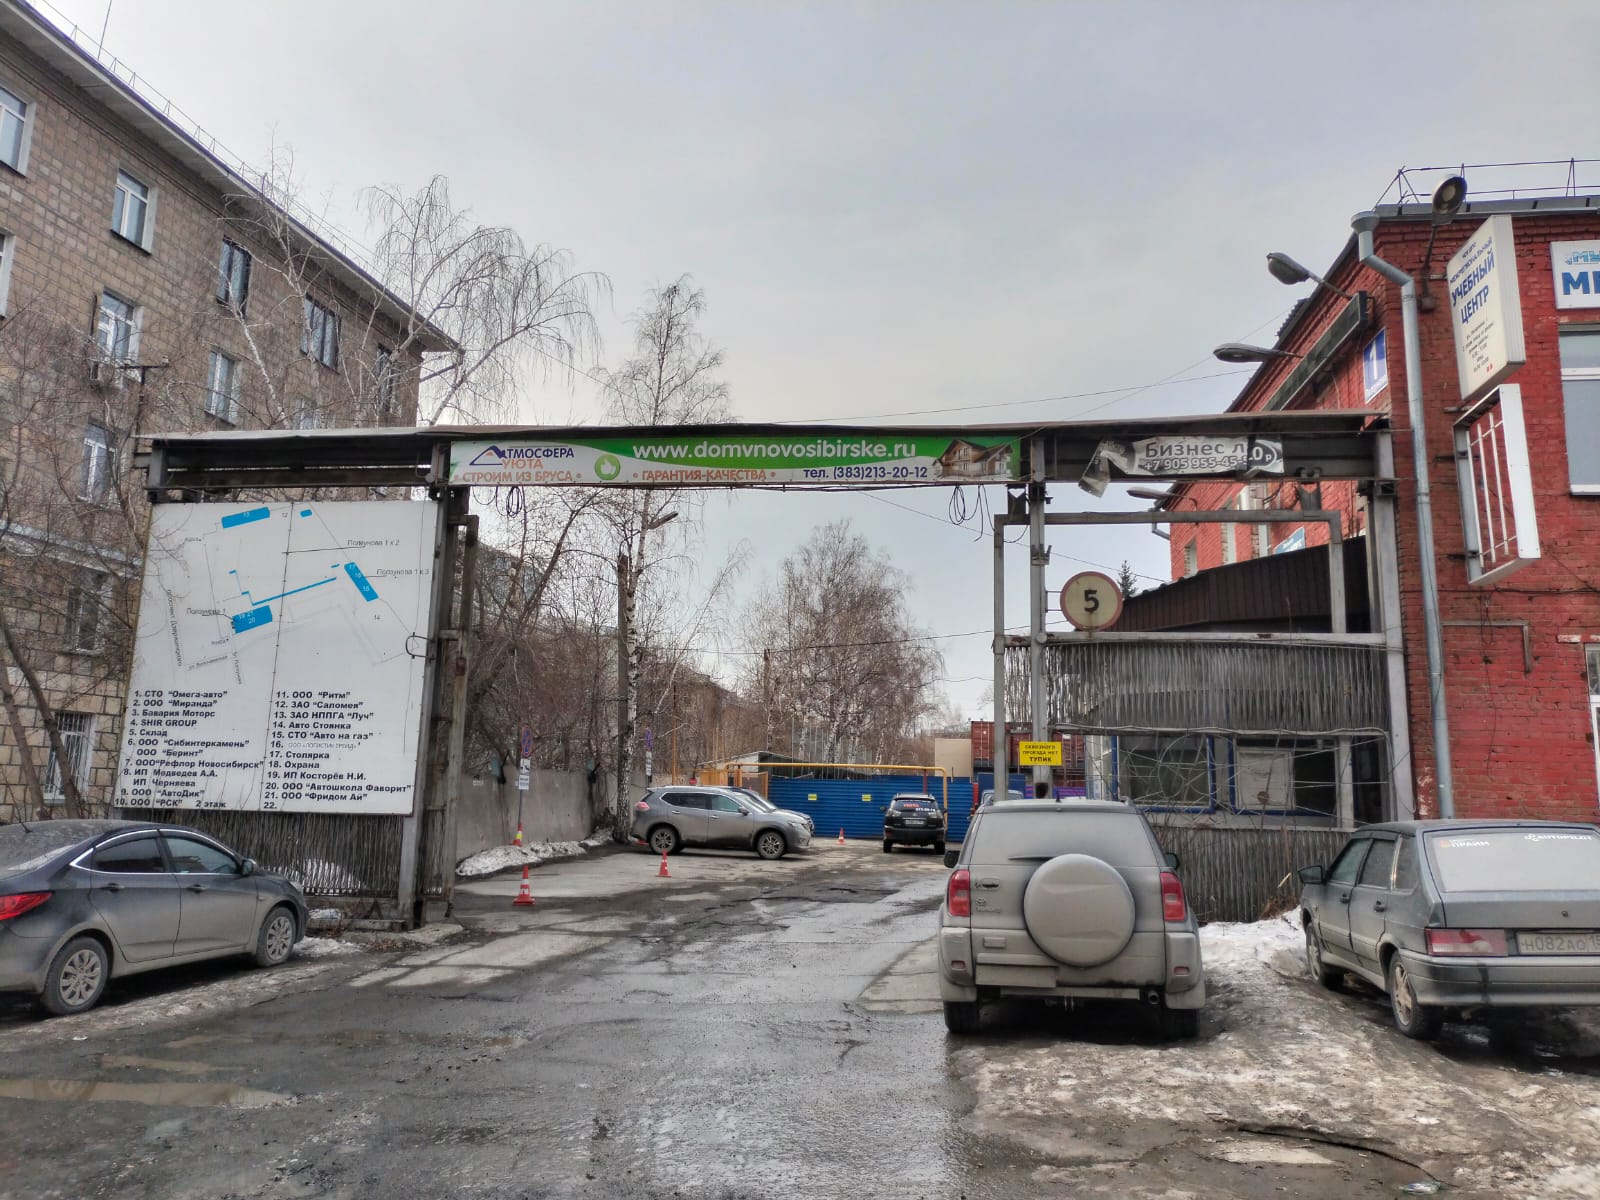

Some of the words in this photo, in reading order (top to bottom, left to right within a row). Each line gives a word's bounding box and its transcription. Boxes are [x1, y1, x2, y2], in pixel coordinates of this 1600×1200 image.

[1452, 247, 1495, 306] УЧЕБНЫЙ
[1461, 285, 1489, 325] ЦЕНТР
[1369, 340, 1378, 380] 1
[632, 440, 916, 459] www.domvnovosibirske.ru
[1146, 442, 1225, 458] Бизнес
[502, 459, 544, 469] УЮТА
[1145, 459, 1160, 471] +7
[1165, 458, 1188, 470] 905
[462, 472, 513, 483] СТРОИМ
[516, 472, 532, 482] ИЗ
[535, 471, 573, 481] БРУСА
[641, 469, 767, 481] ГАРАНТИЯ-КАЧЕСТВА
[803, 467, 829, 479] тел.
[833, 466, 928, 480] (383)213-20-12
[1084, 589, 1100, 613] 5
[134, 690, 141, 698] 1.
[144, 690, 163, 698] СТО
[168, 690, 228, 698] “Омега-авто”
[168, 700, 217, 708] “Миранда”
[312, 701, 364, 709] “Саломея”
[142, 709, 180, 718] Бавария
[182, 710, 216, 718] Моторс
[347, 712, 374, 720] “Луч”
[312, 722, 352, 730] Стоянка
[140, 729, 168, 737] Склад
[310, 732, 336, 740] “Авто
[352, 732, 374, 740] газ”
[164, 740, 250, 748] “Сибинтеркамень”
[162, 749, 204, 758] “Беринт”
[198, 760, 264, 769] Новосибирск”
[284, 761, 320, 769] Охрана
[124, 768, 132, 776] 8.
[152, 769, 198, 777] Медведев
[152, 779, 196, 787] Черняева
[120, 788, 129, 796] 9.
[132, 788, 152, 796] ООО
[266, 782, 280, 790] 20.
[282, 782, 303, 790] ООО
[306, 784, 363, 792] “Автошкола
[366, 784, 412, 794] Фаворит”
[282, 792, 302, 800] ООО
[304, 792, 347, 801] “Фридом
[115, 798, 127, 806] 10.
[130, 798, 150, 806] ООО
